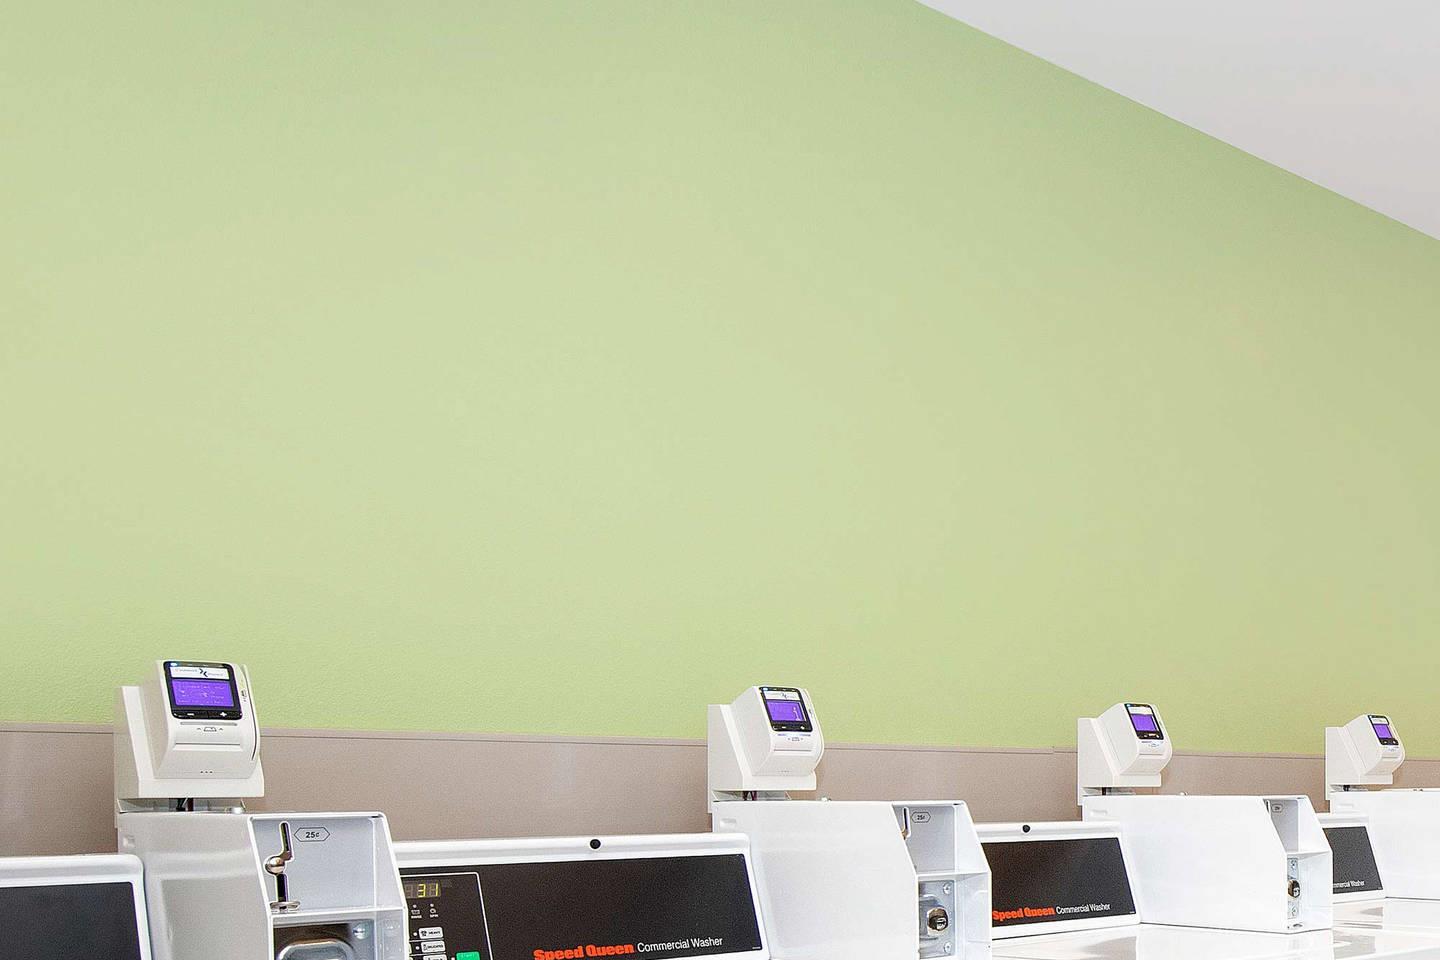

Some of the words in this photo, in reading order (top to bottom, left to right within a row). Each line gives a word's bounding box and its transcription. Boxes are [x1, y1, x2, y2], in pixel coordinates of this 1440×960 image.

[417, 883, 439, 898] 31
[992, 908, 1024, 921] Speed
[1024, 907, 1056, 918] Queen
[1056, 905, 1089, 915] Commercial
[1089, 902, 1111, 912] Washer
[586, 943, 635, 959] Queen
[637, 938, 690, 953] Commercial
[691, 936, 723, 948] Washer
